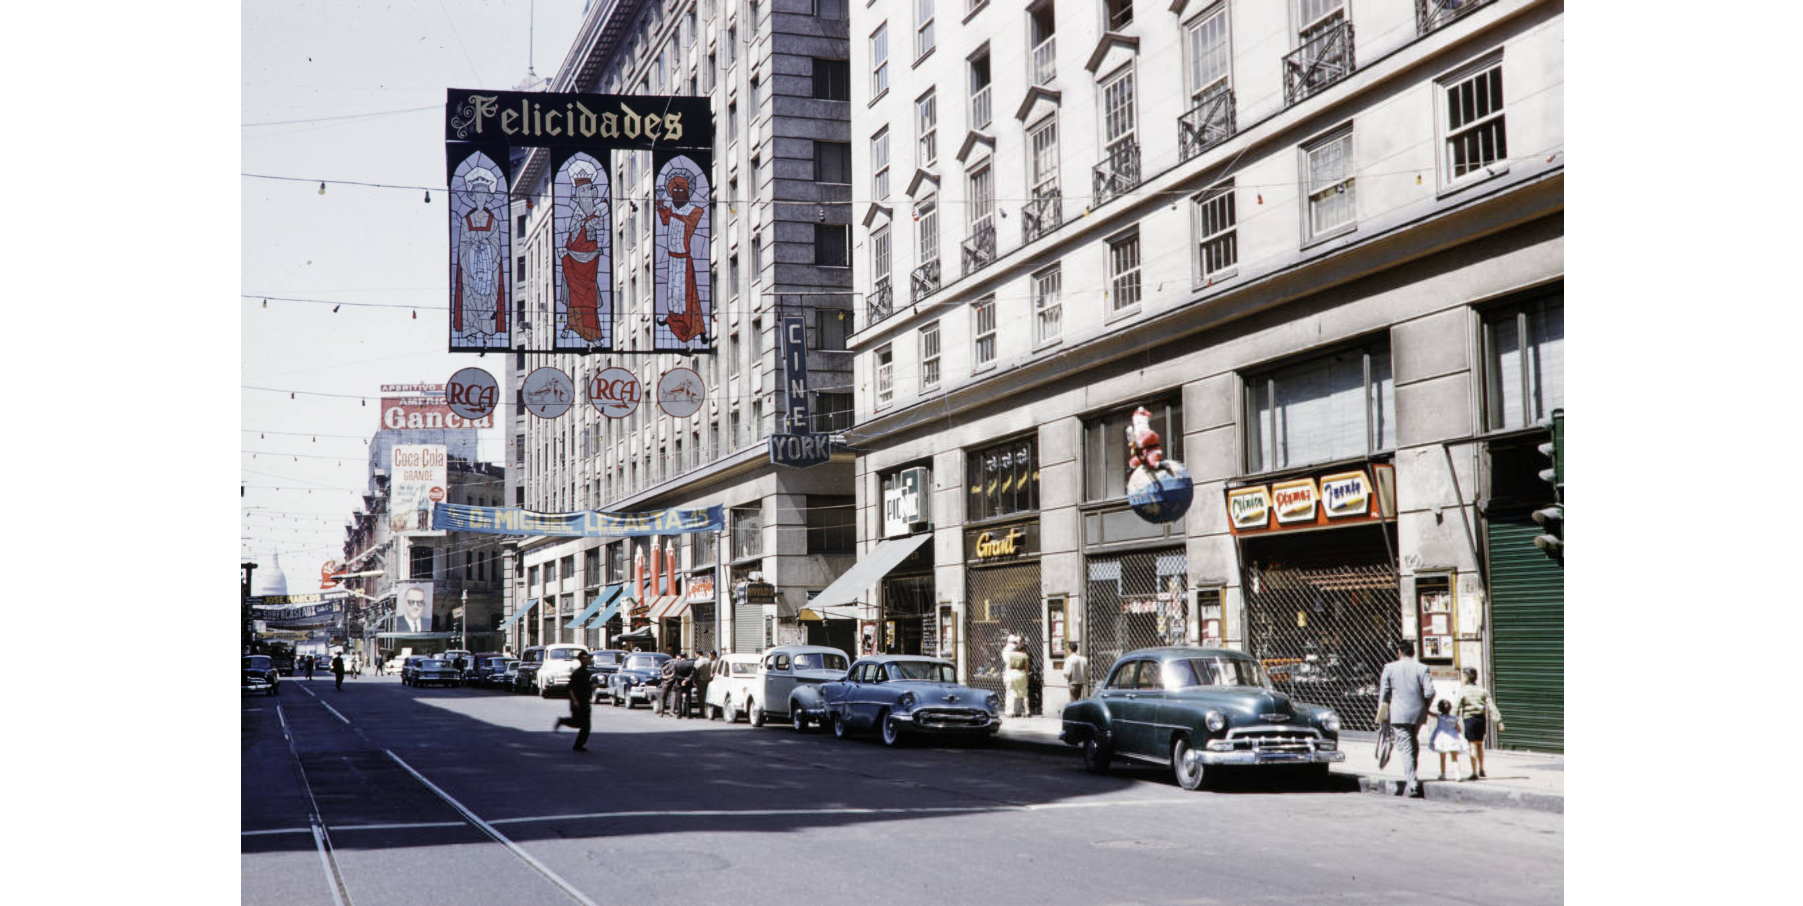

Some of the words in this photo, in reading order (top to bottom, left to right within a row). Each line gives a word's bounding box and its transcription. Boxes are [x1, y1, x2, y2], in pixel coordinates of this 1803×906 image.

[462, 94, 683, 140] Felicidades
[789, 324, 806, 427] CINE
[381, 384, 437, 392] APERITIVO
[450, 382, 496, 408] RCA
[590, 377, 637, 403] RCA
[399, 397, 447, 406] AMERIC
[394, 447, 444, 467] Coca-Cola
[773, 435, 828, 461] YORK
[403, 470, 434, 481] GRANDE
[494, 508, 573, 531] MIGUEL
[584, 509, 682, 531] LEZAETA
[976, 528, 1022, 558] Grant
[263, 595, 286, 605] JOSE
[287, 593, 321, 604] MARCOS
